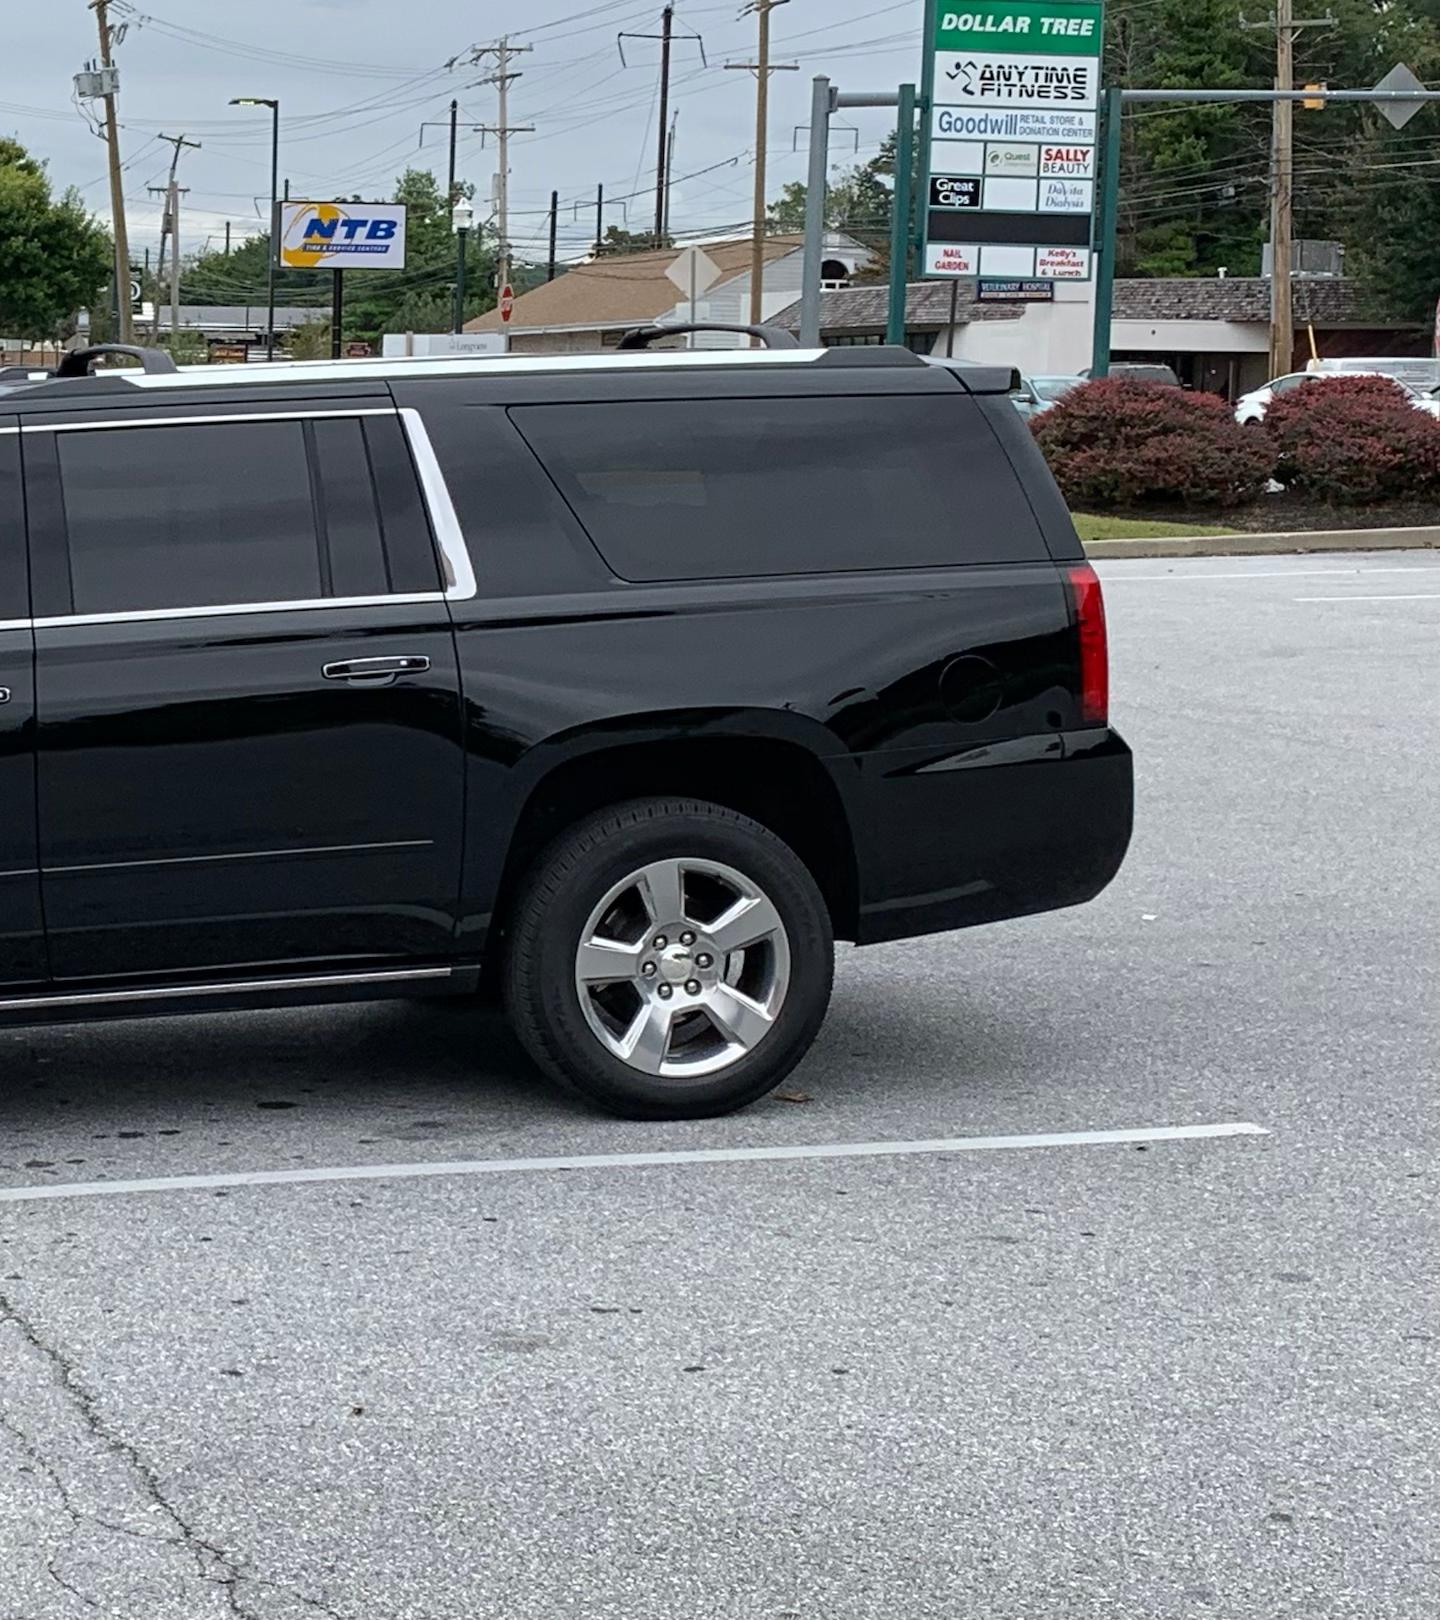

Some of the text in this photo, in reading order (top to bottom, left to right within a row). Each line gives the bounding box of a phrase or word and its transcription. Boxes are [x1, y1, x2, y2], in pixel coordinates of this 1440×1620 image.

[941, 13, 1095, 36] DOLLAR TREE
[979, 64, 1088, 85] ANYTIME
[980, 83, 1086, 100] FITNESS
[938, 111, 1018, 136] Goodwill
[1019, 114, 1047, 125] RETAIL
[1049, 115, 1076, 126] STORE
[1018, 126, 1093, 138] DONATION CENTER
[1004, 152, 1031, 161] Quest
[1044, 148, 1090, 162] SALLY
[1042, 162, 1090, 174] BEAUTY
[936, 178, 974, 192] Great
[939, 191, 970, 207] Clips
[303, 218, 398, 240] NTB
[943, 249, 962, 259] NAIL
[935, 260, 969, 271] GARDEN
[1039, 258, 1084, 268] Breakfast
